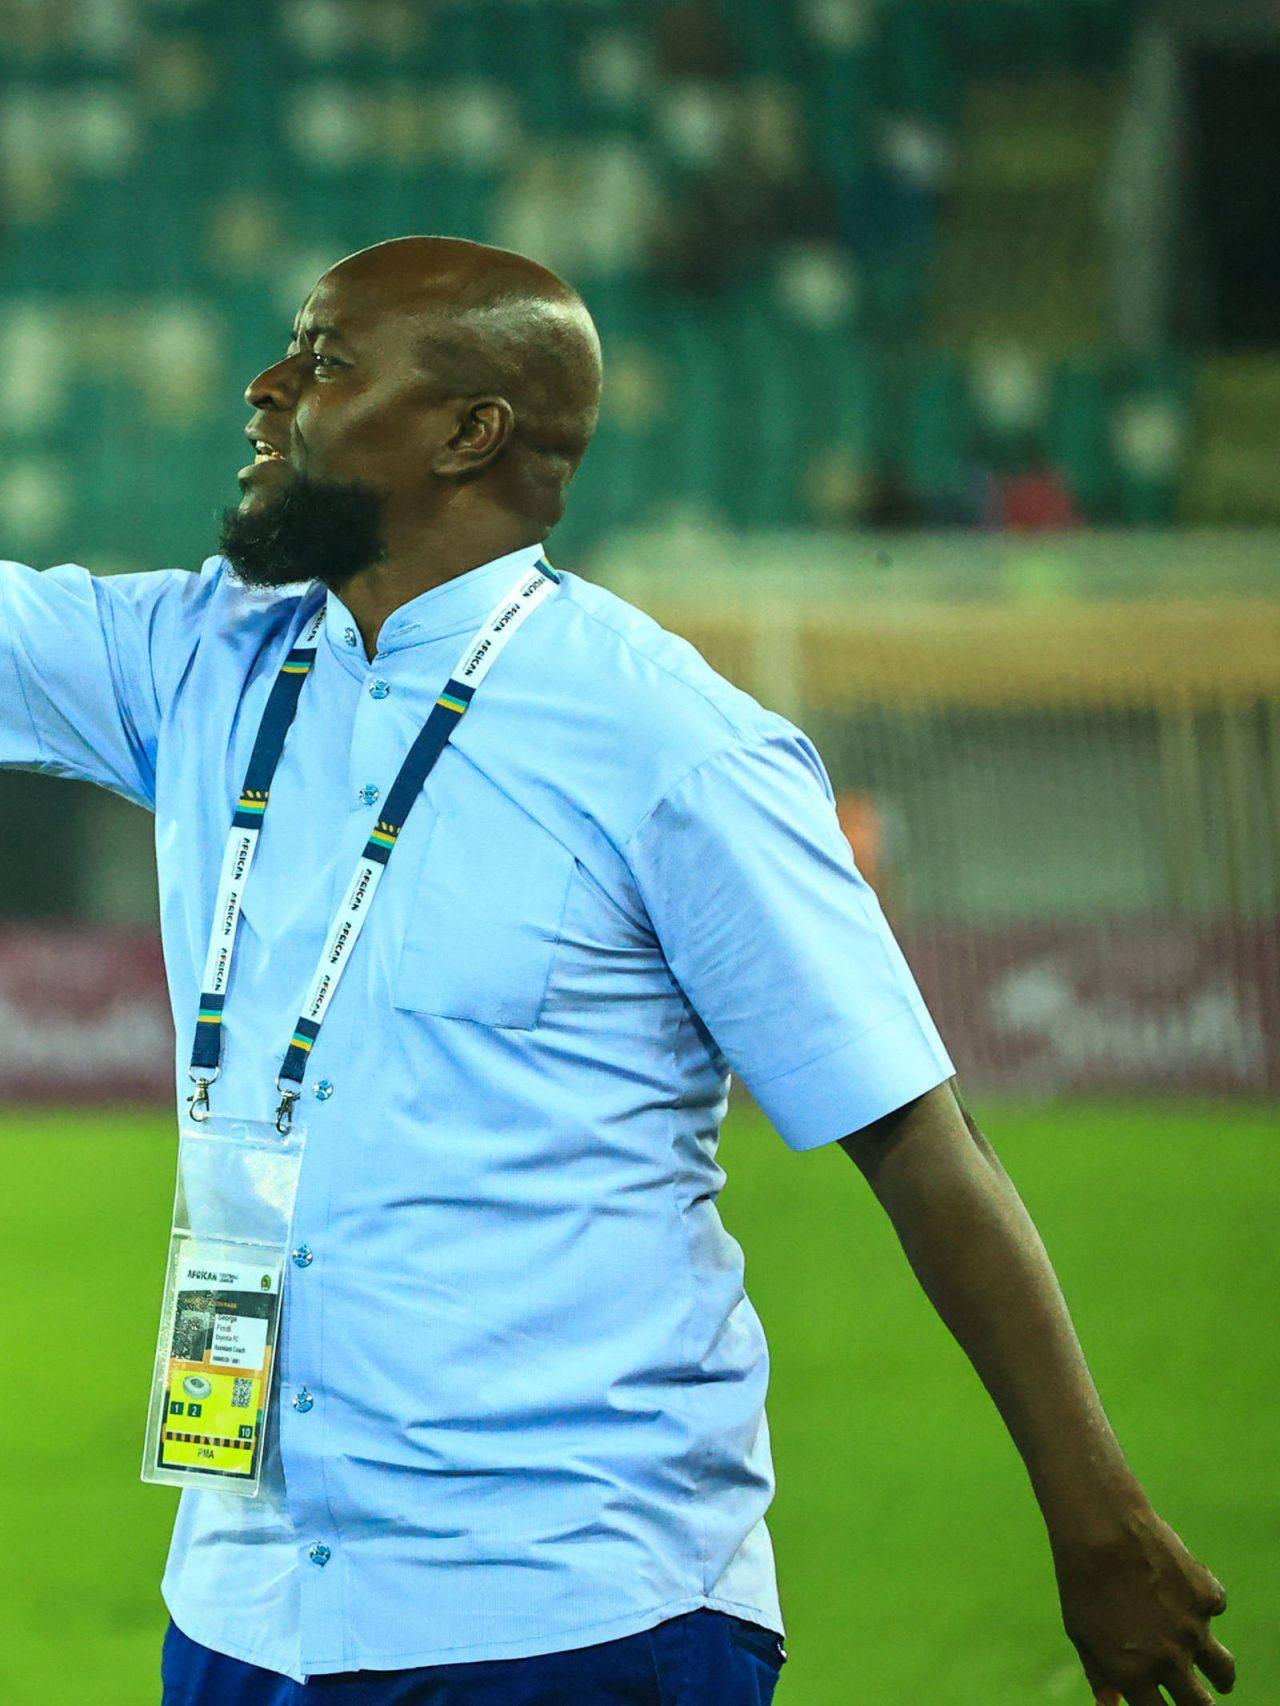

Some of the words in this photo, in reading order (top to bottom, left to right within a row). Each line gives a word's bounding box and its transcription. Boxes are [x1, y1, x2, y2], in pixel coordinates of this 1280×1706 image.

[493, 603, 520, 632] AFRICAN
[465, 639, 492, 676] AFRICAN
[234, 837, 250, 880] AFRICAN
[351, 868, 372, 911] AFRICAN
[224, 892, 237, 936] AFRICAN
[330, 921, 351, 964] AFRICAN
[214, 947, 227, 991] AFRICAN
[311, 974, 331, 1017] AFRICAN
[187, 1269, 217, 1281] AFRICAN
